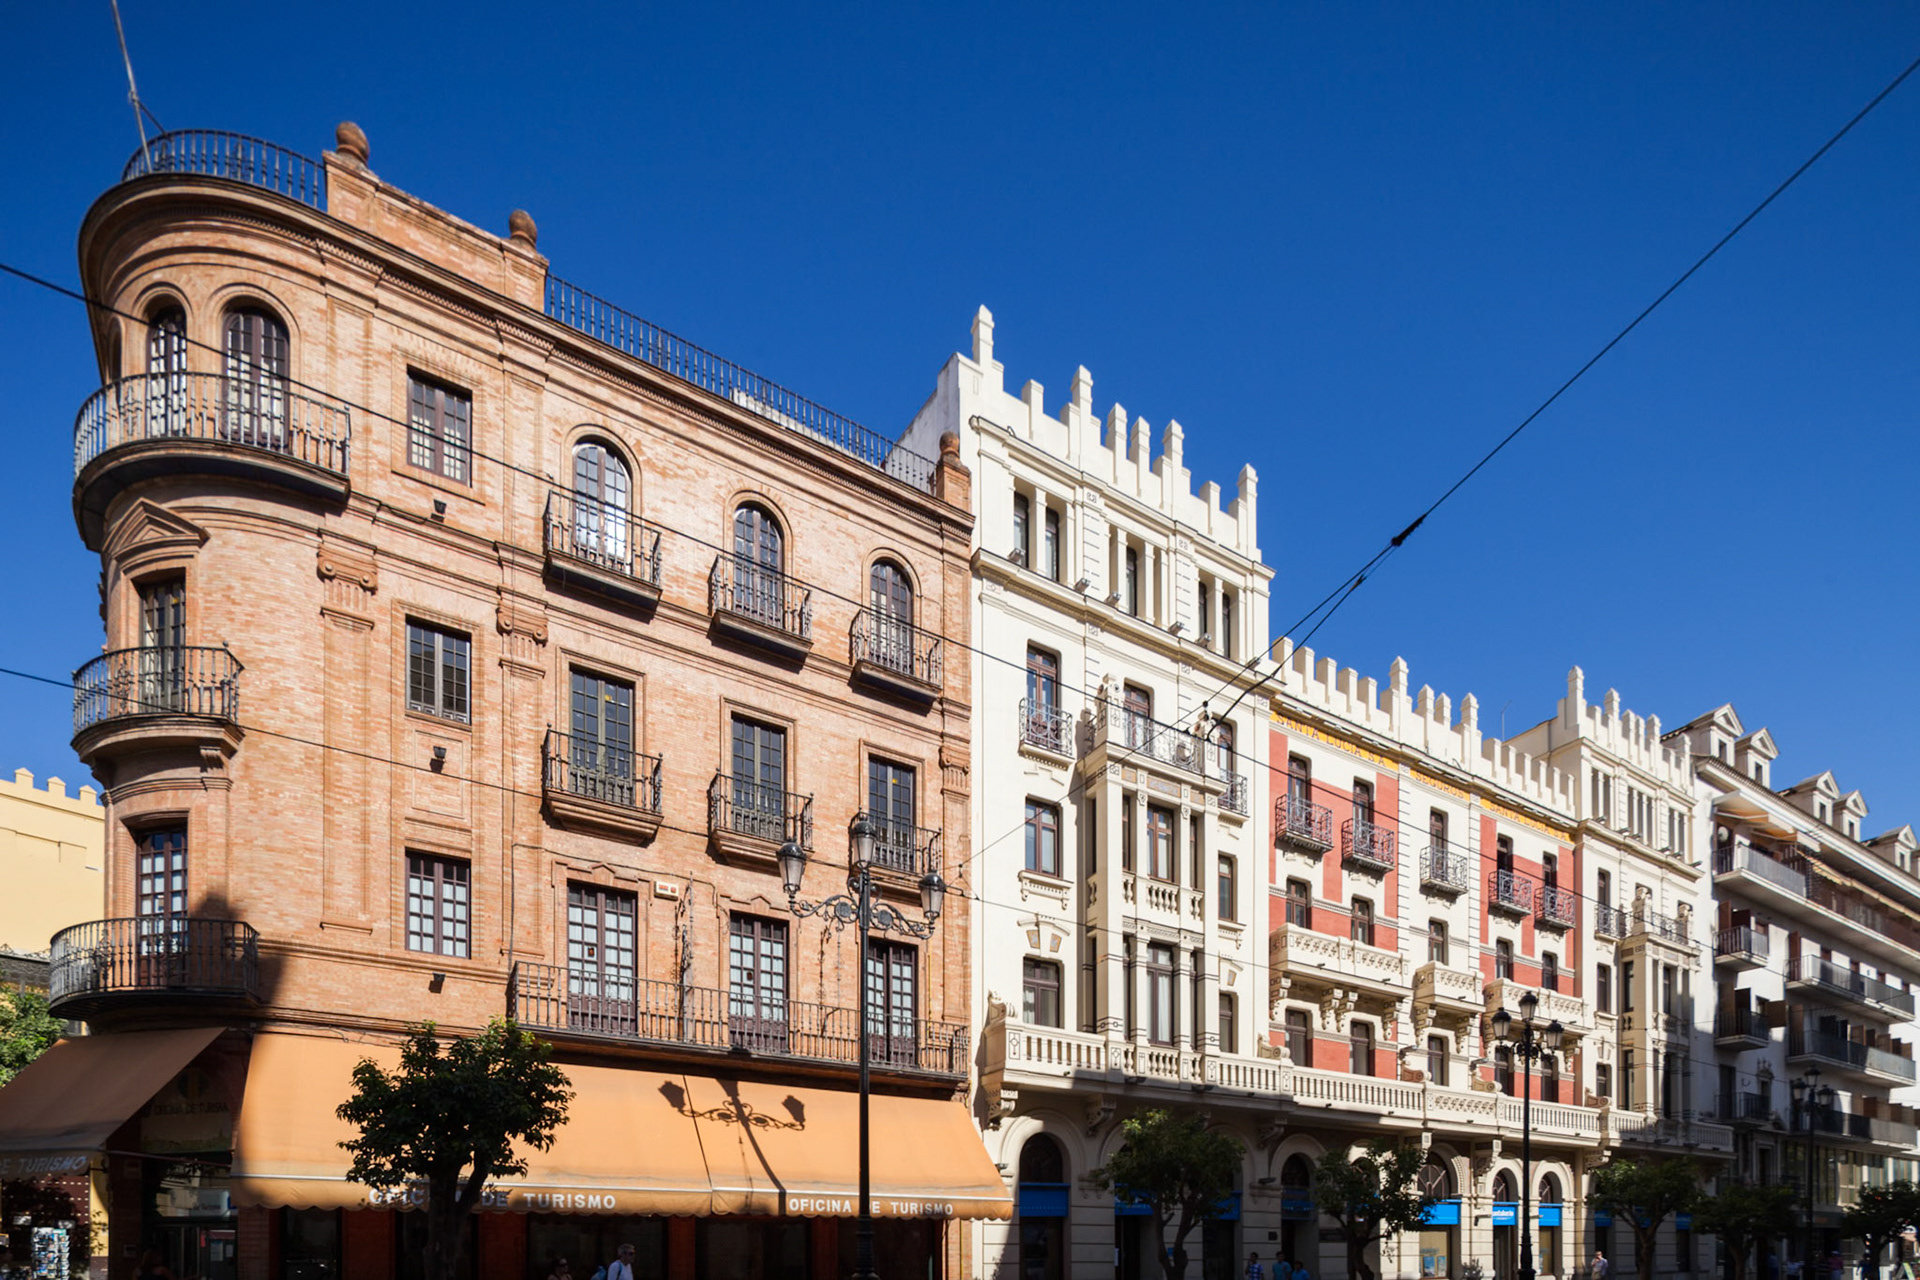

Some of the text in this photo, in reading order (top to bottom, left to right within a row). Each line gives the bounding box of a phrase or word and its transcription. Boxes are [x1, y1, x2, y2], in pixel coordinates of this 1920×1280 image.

[1276, 714, 1320, 740] SANTA
[1326, 735, 1362, 757] LUCIA
[1415, 772, 1464, 799] SEGUROS
[1489, 804, 1521, 822] SANTA
[0, 1156, 87, 1174] E TURISMO
[482, 1191, 508, 1207] DE
[523, 1192, 616, 1209] TURISMO
[789, 1198, 852, 1213] OFICINA
[891, 1202, 953, 1215] TURISMO
